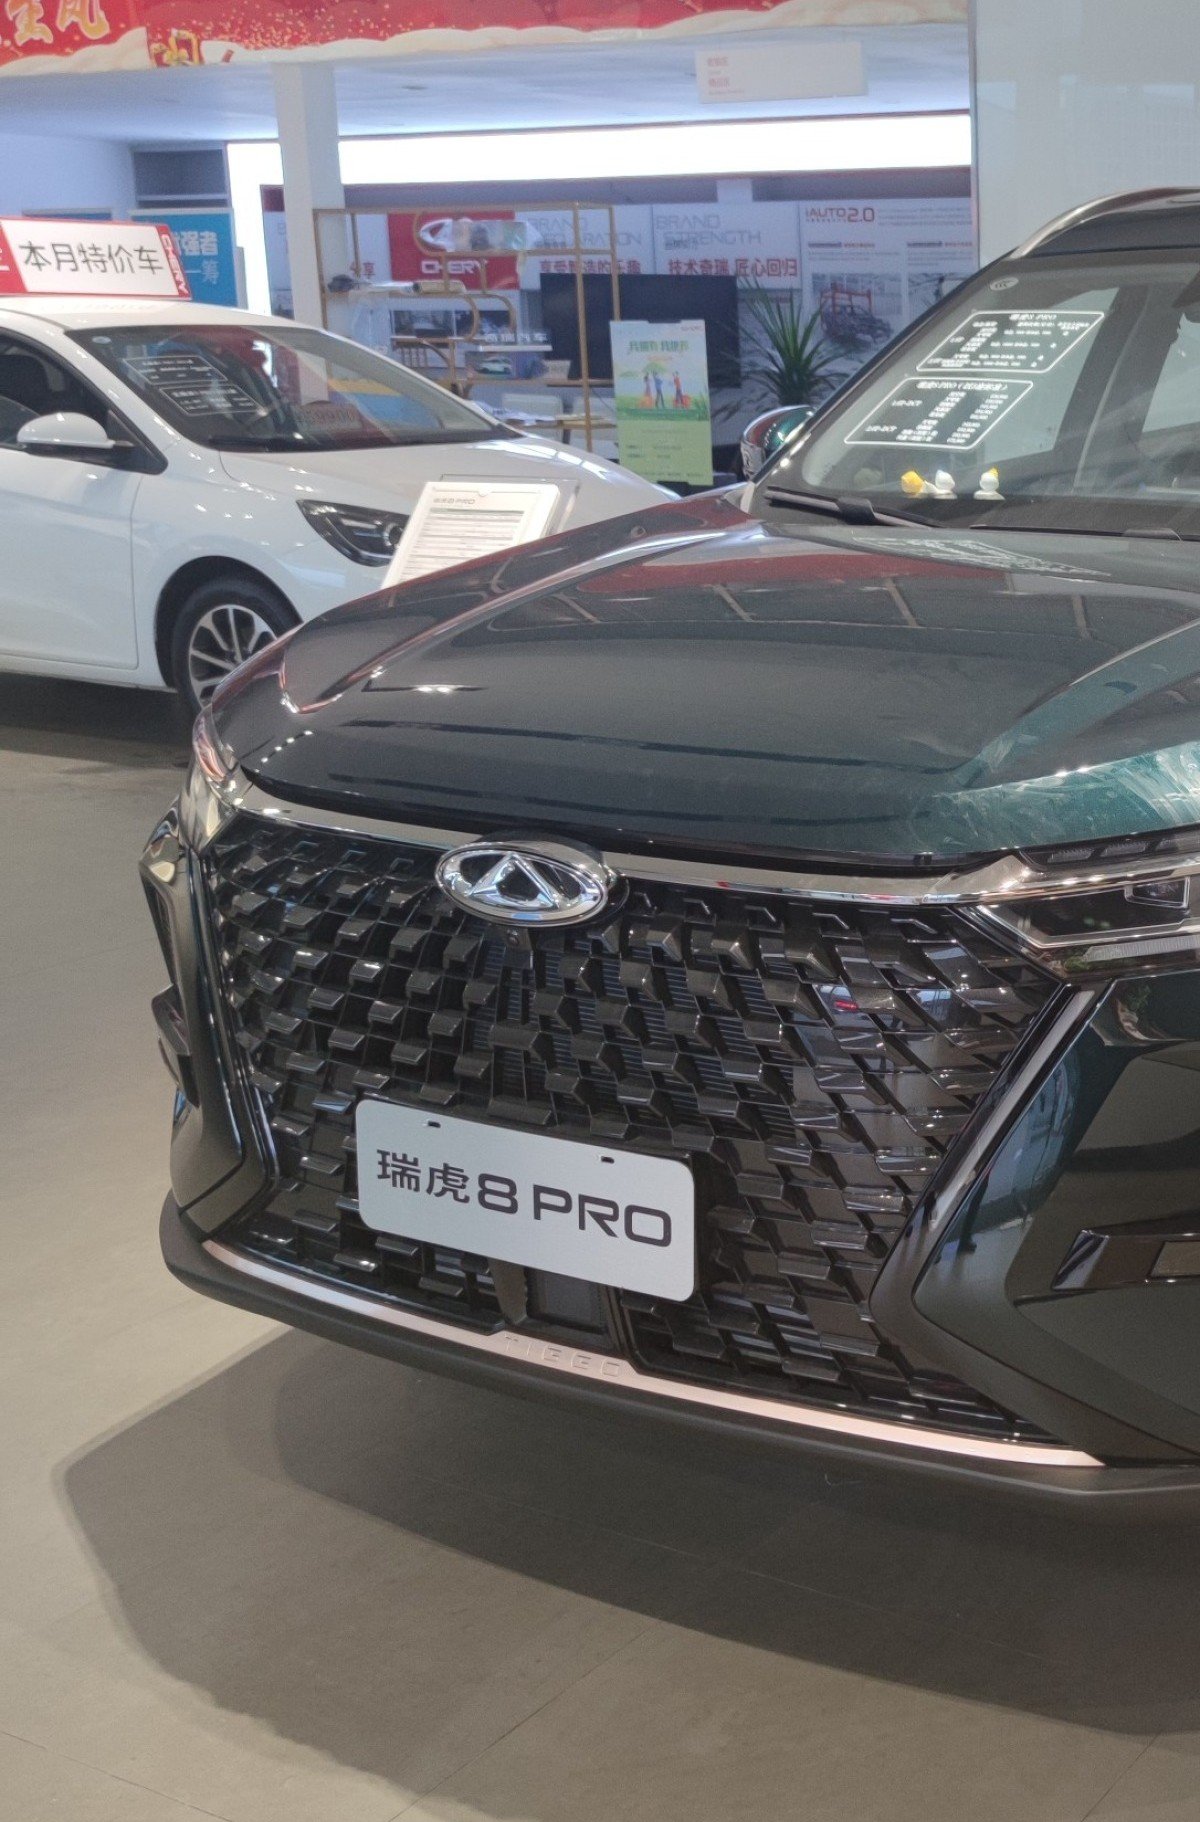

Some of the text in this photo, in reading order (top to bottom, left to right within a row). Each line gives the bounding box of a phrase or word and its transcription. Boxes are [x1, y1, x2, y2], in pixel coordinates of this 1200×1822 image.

[656, 214, 721, 230] BRAND
[19, 241, 163, 274] 本月特价车
[668, 257, 798, 277] 技术奇瑞 匠心回归
[376, 1149, 672, 1248] 瑞虎8 PRO
